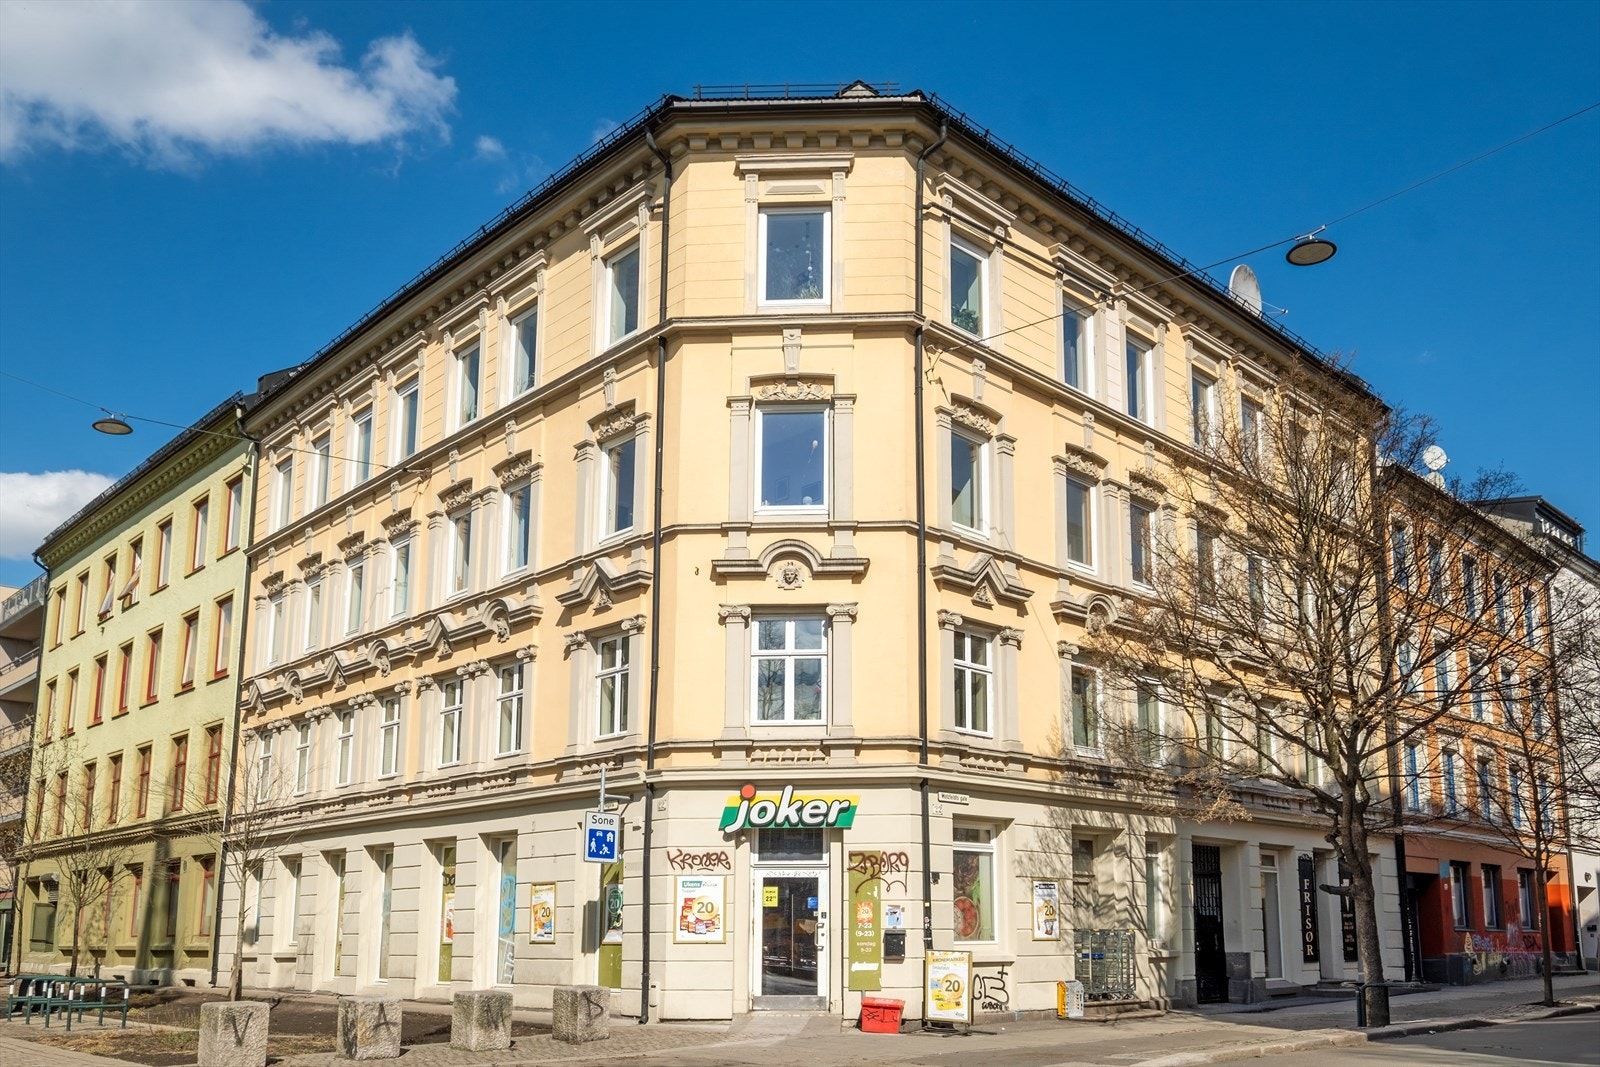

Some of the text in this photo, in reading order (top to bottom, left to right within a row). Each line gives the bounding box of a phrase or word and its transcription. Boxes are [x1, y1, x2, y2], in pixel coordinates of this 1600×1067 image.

[724, 784, 850, 833] joker
[591, 815, 615, 826] Sone
[541, 906, 551, 918] 20
[697, 902, 715, 914] 20
[1044, 905, 1054, 916] 20
[1303, 878, 1314, 956] FRISØR
[945, 979, 960, 993] 20
